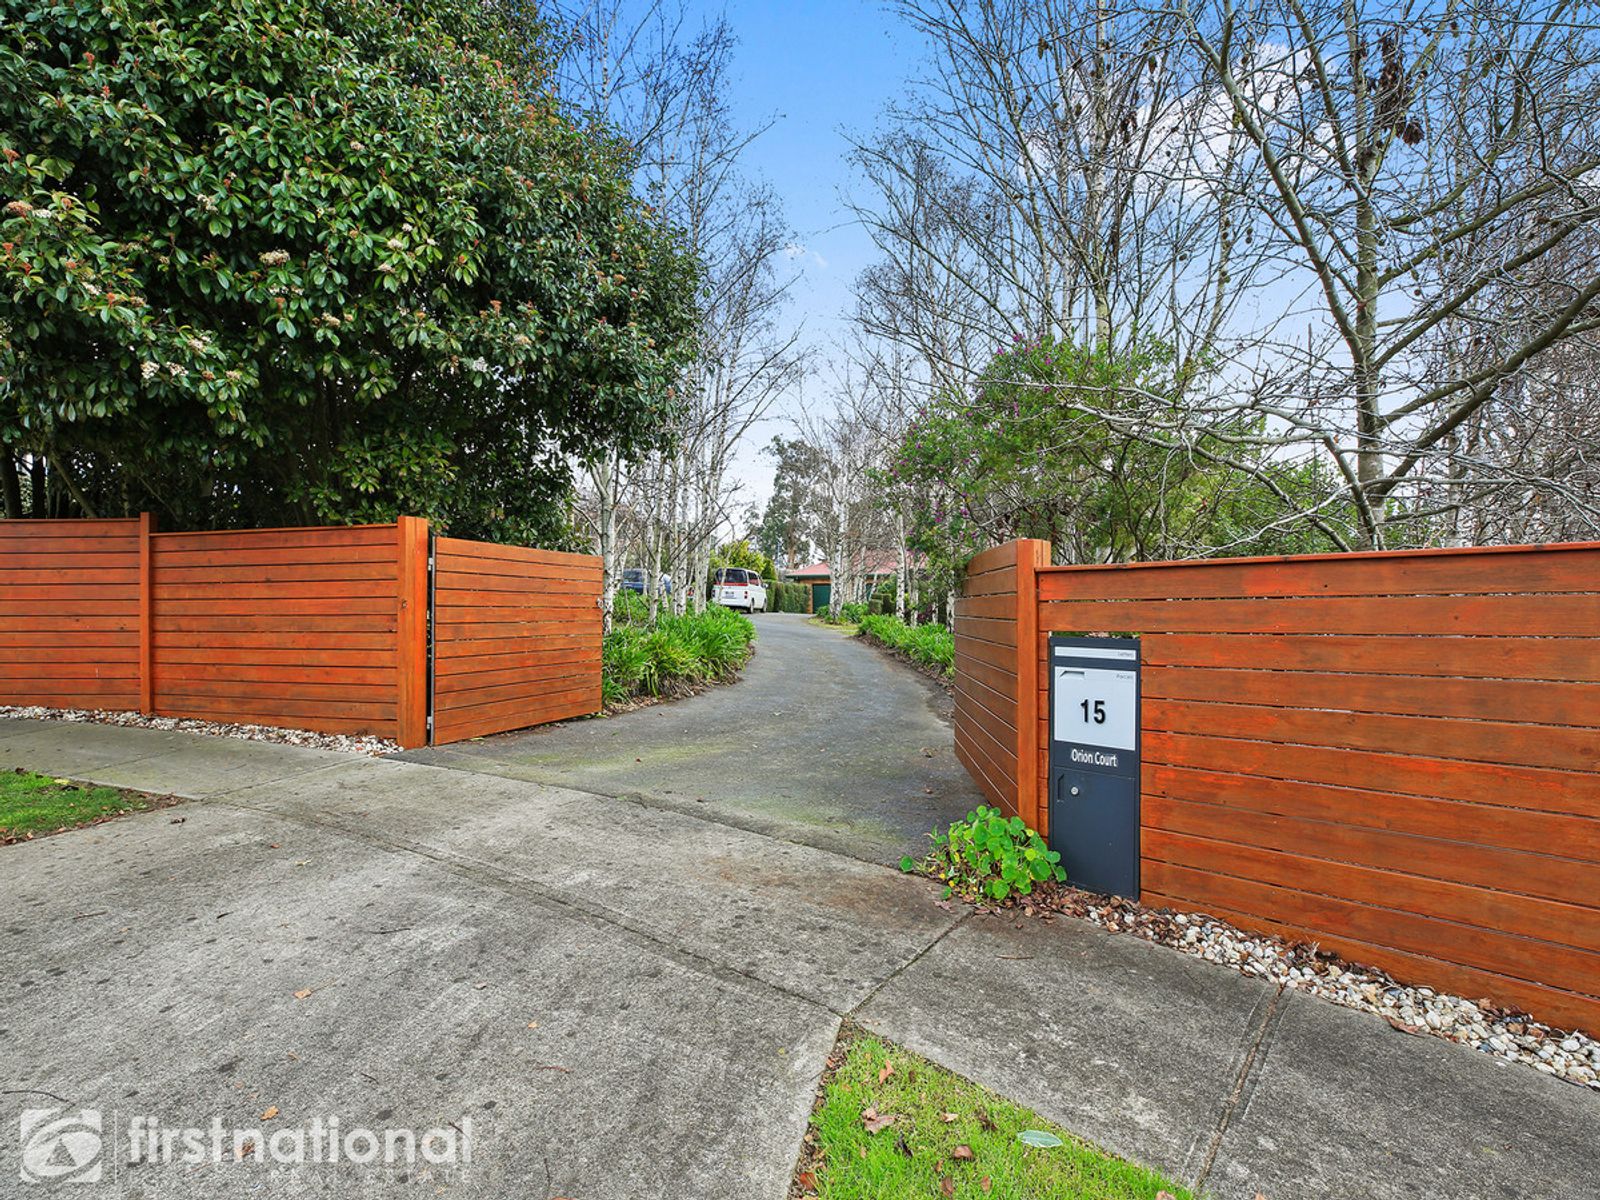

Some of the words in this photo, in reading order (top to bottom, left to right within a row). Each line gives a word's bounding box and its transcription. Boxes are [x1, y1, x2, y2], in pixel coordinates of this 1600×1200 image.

[1081, 699, 1106, 724] 15
[1071, 748, 1093, 764] Orion
[1094, 752, 1117, 767] Court
